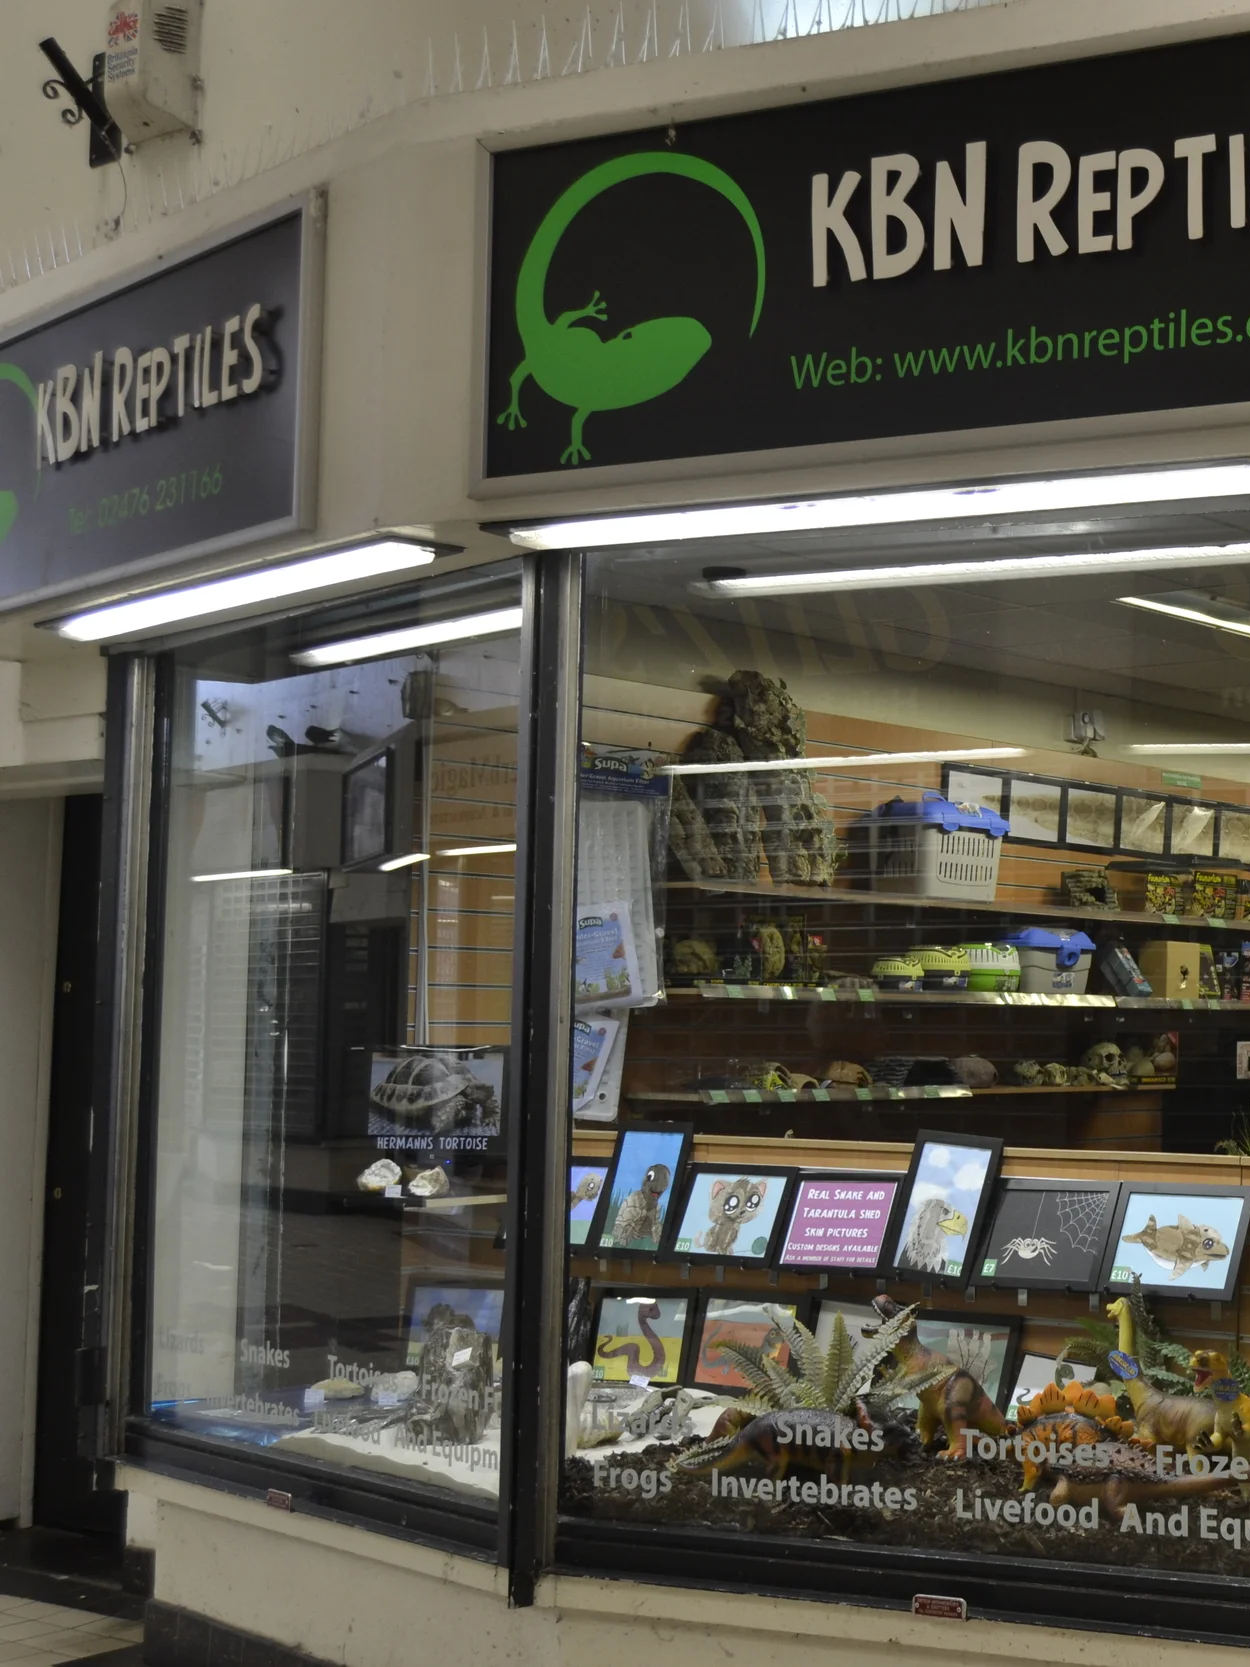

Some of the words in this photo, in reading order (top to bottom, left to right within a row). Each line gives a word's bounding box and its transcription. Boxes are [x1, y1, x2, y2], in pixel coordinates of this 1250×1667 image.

[812, 140, 987, 288] KBN
[790, 345, 884, 390] Web:
[37, 350, 104, 470] KBN
[112, 303, 263, 443] REPTILES
[98, 485, 151, 527] 02476
[594, 757, 627, 772] Supa
[577, 928, 618, 940] der-Gravel
[579, 919, 602, 929] Supa
[574, 1021, 591, 1034] upa
[377, 1136, 434, 1150] HERMANNS
[439, 1136, 488, 1151] TORTOISE
[808, 1189, 830, 1200] REAL
[834, 1189, 863, 1200] SNAKE
[866, 1190, 885, 1200] AND
[803, 1207, 856, 1219] TARANTULA
[859, 1209, 881, 1219] SHED
[600, 1237, 614, 1248] £10
[676, 1241, 690, 1250] £10
[788, 1243, 814, 1251] CUSTOM
[816, 1244, 840, 1252] DESIGNS
[843, 1245, 879, 1253] AVAILABLE
[804, 1227, 824, 1237] SKIN
[827, 1228, 868, 1238] PICTURES
[983, 1263, 995, 1273] £7
[1110, 1270, 1128, 1282] £10
[158, 1325, 205, 1355] Lizards
[240, 1337, 291, 1369] Snakes
[328, 1354, 398, 1394] Tortoises
[406, 1356, 419, 1365] £10
[422, 1373, 479, 1410] Frozen
[206, 1389, 300, 1427] Invertebrates
[591, 1402, 693, 1437] Lizards
[395, 1425, 428, 1454] And
[432, 1430, 499, 1472] Equipm
[776, 1416, 884, 1452] Snakes
[960, 1428, 1110, 1469] Tortoises
[593, 1459, 673, 1499] Frogs
[712, 1468, 917, 1512] Invertebrates
[956, 1489, 1099, 1529] Livefood
[1120, 1503, 1189, 1538] And
